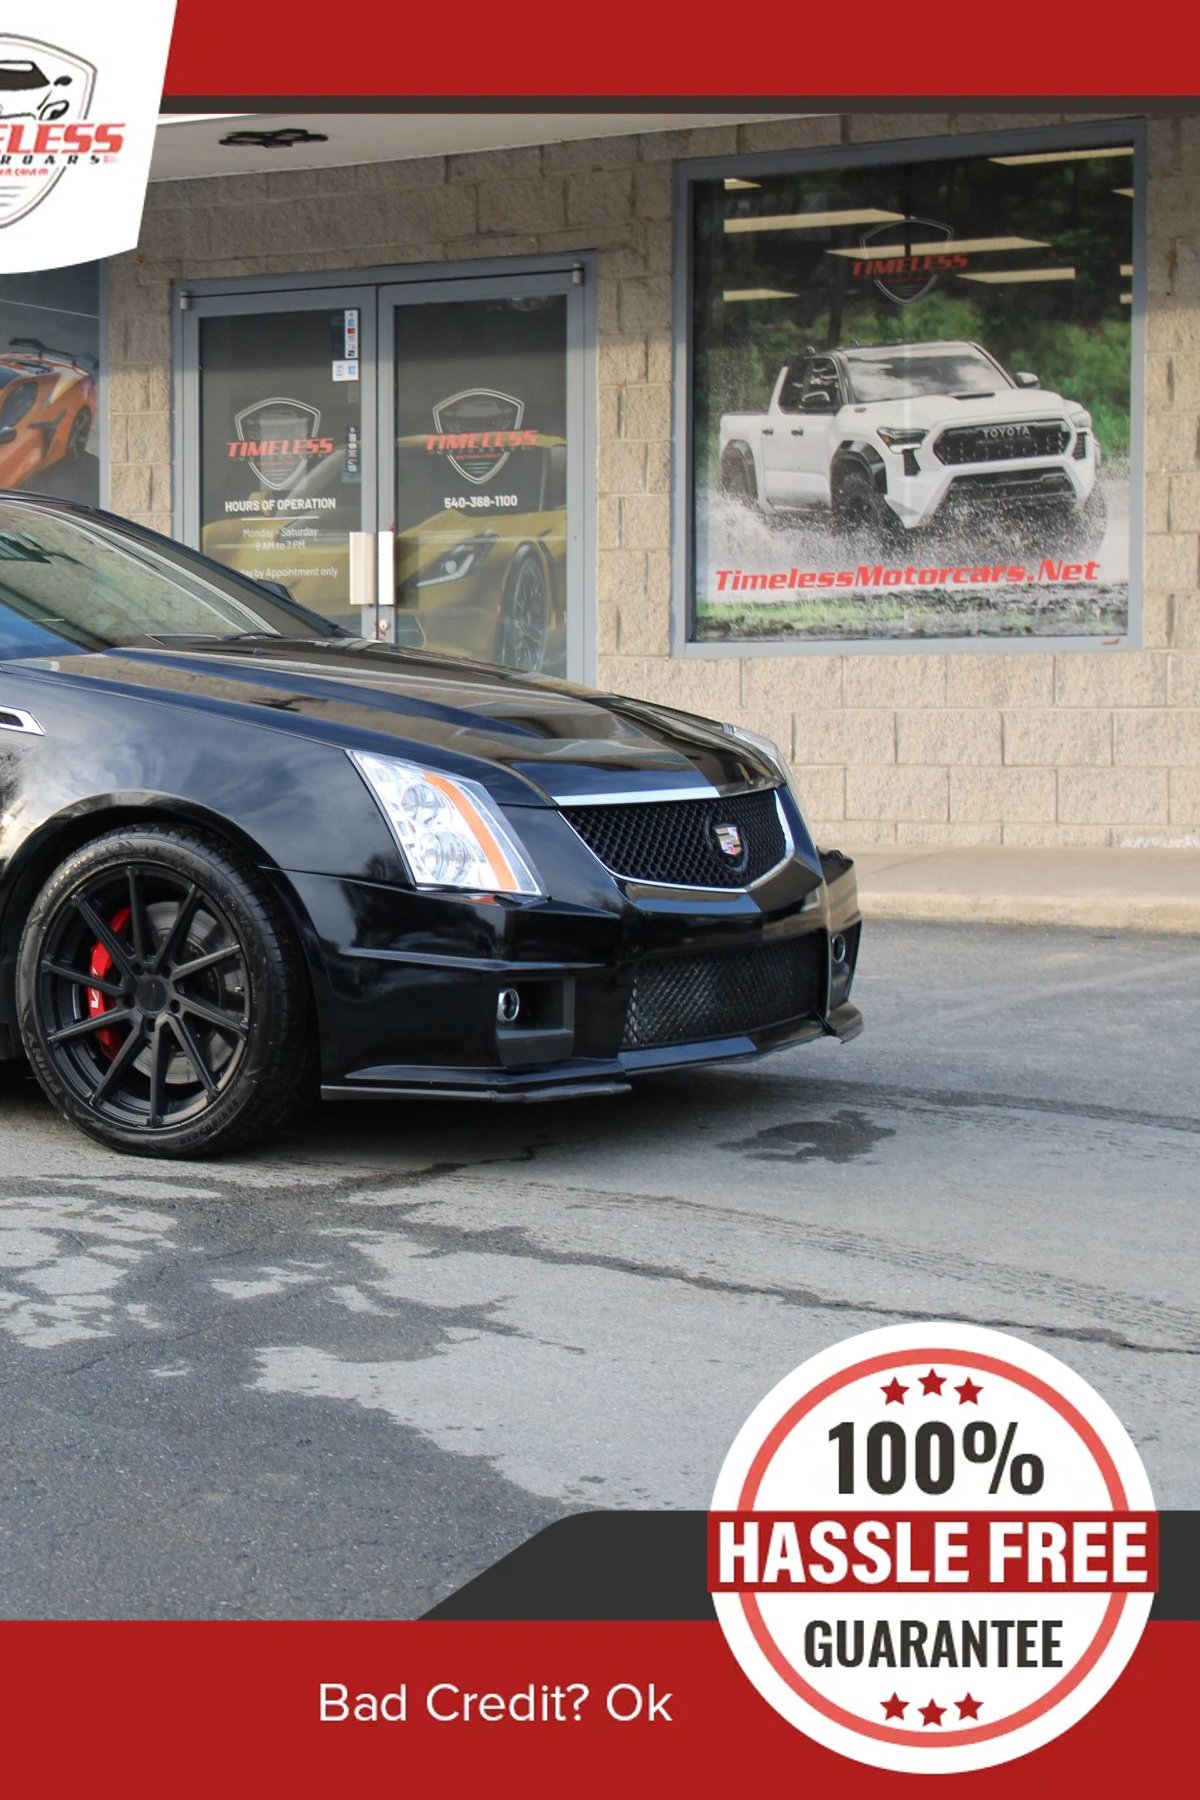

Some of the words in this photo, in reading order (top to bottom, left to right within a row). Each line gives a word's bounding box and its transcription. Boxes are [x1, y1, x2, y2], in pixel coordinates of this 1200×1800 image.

[852, 253, 968, 276] TIMELESS
[982, 424, 1030, 439] TOYOTA
[225, 437, 334, 458] TIMELESS
[426, 429, 539, 451] TIMELESS
[225, 501, 260, 512] HOURS
[261, 500, 275, 511] OF
[277, 497, 336, 510] OPERATION
[443, 495, 518, 509] 540-368-1100
[243, 528, 273, 538] Monday
[280, 527, 318, 540] Saturday
[277, 540, 285, 550] to
[293, 540, 305, 549] PM
[255, 568, 264, 578] by
[266, 567, 319, 578] Appointment
[321, 566, 338, 578] only
[715, 559, 1101, 592] TimelessMotorcars.Net
